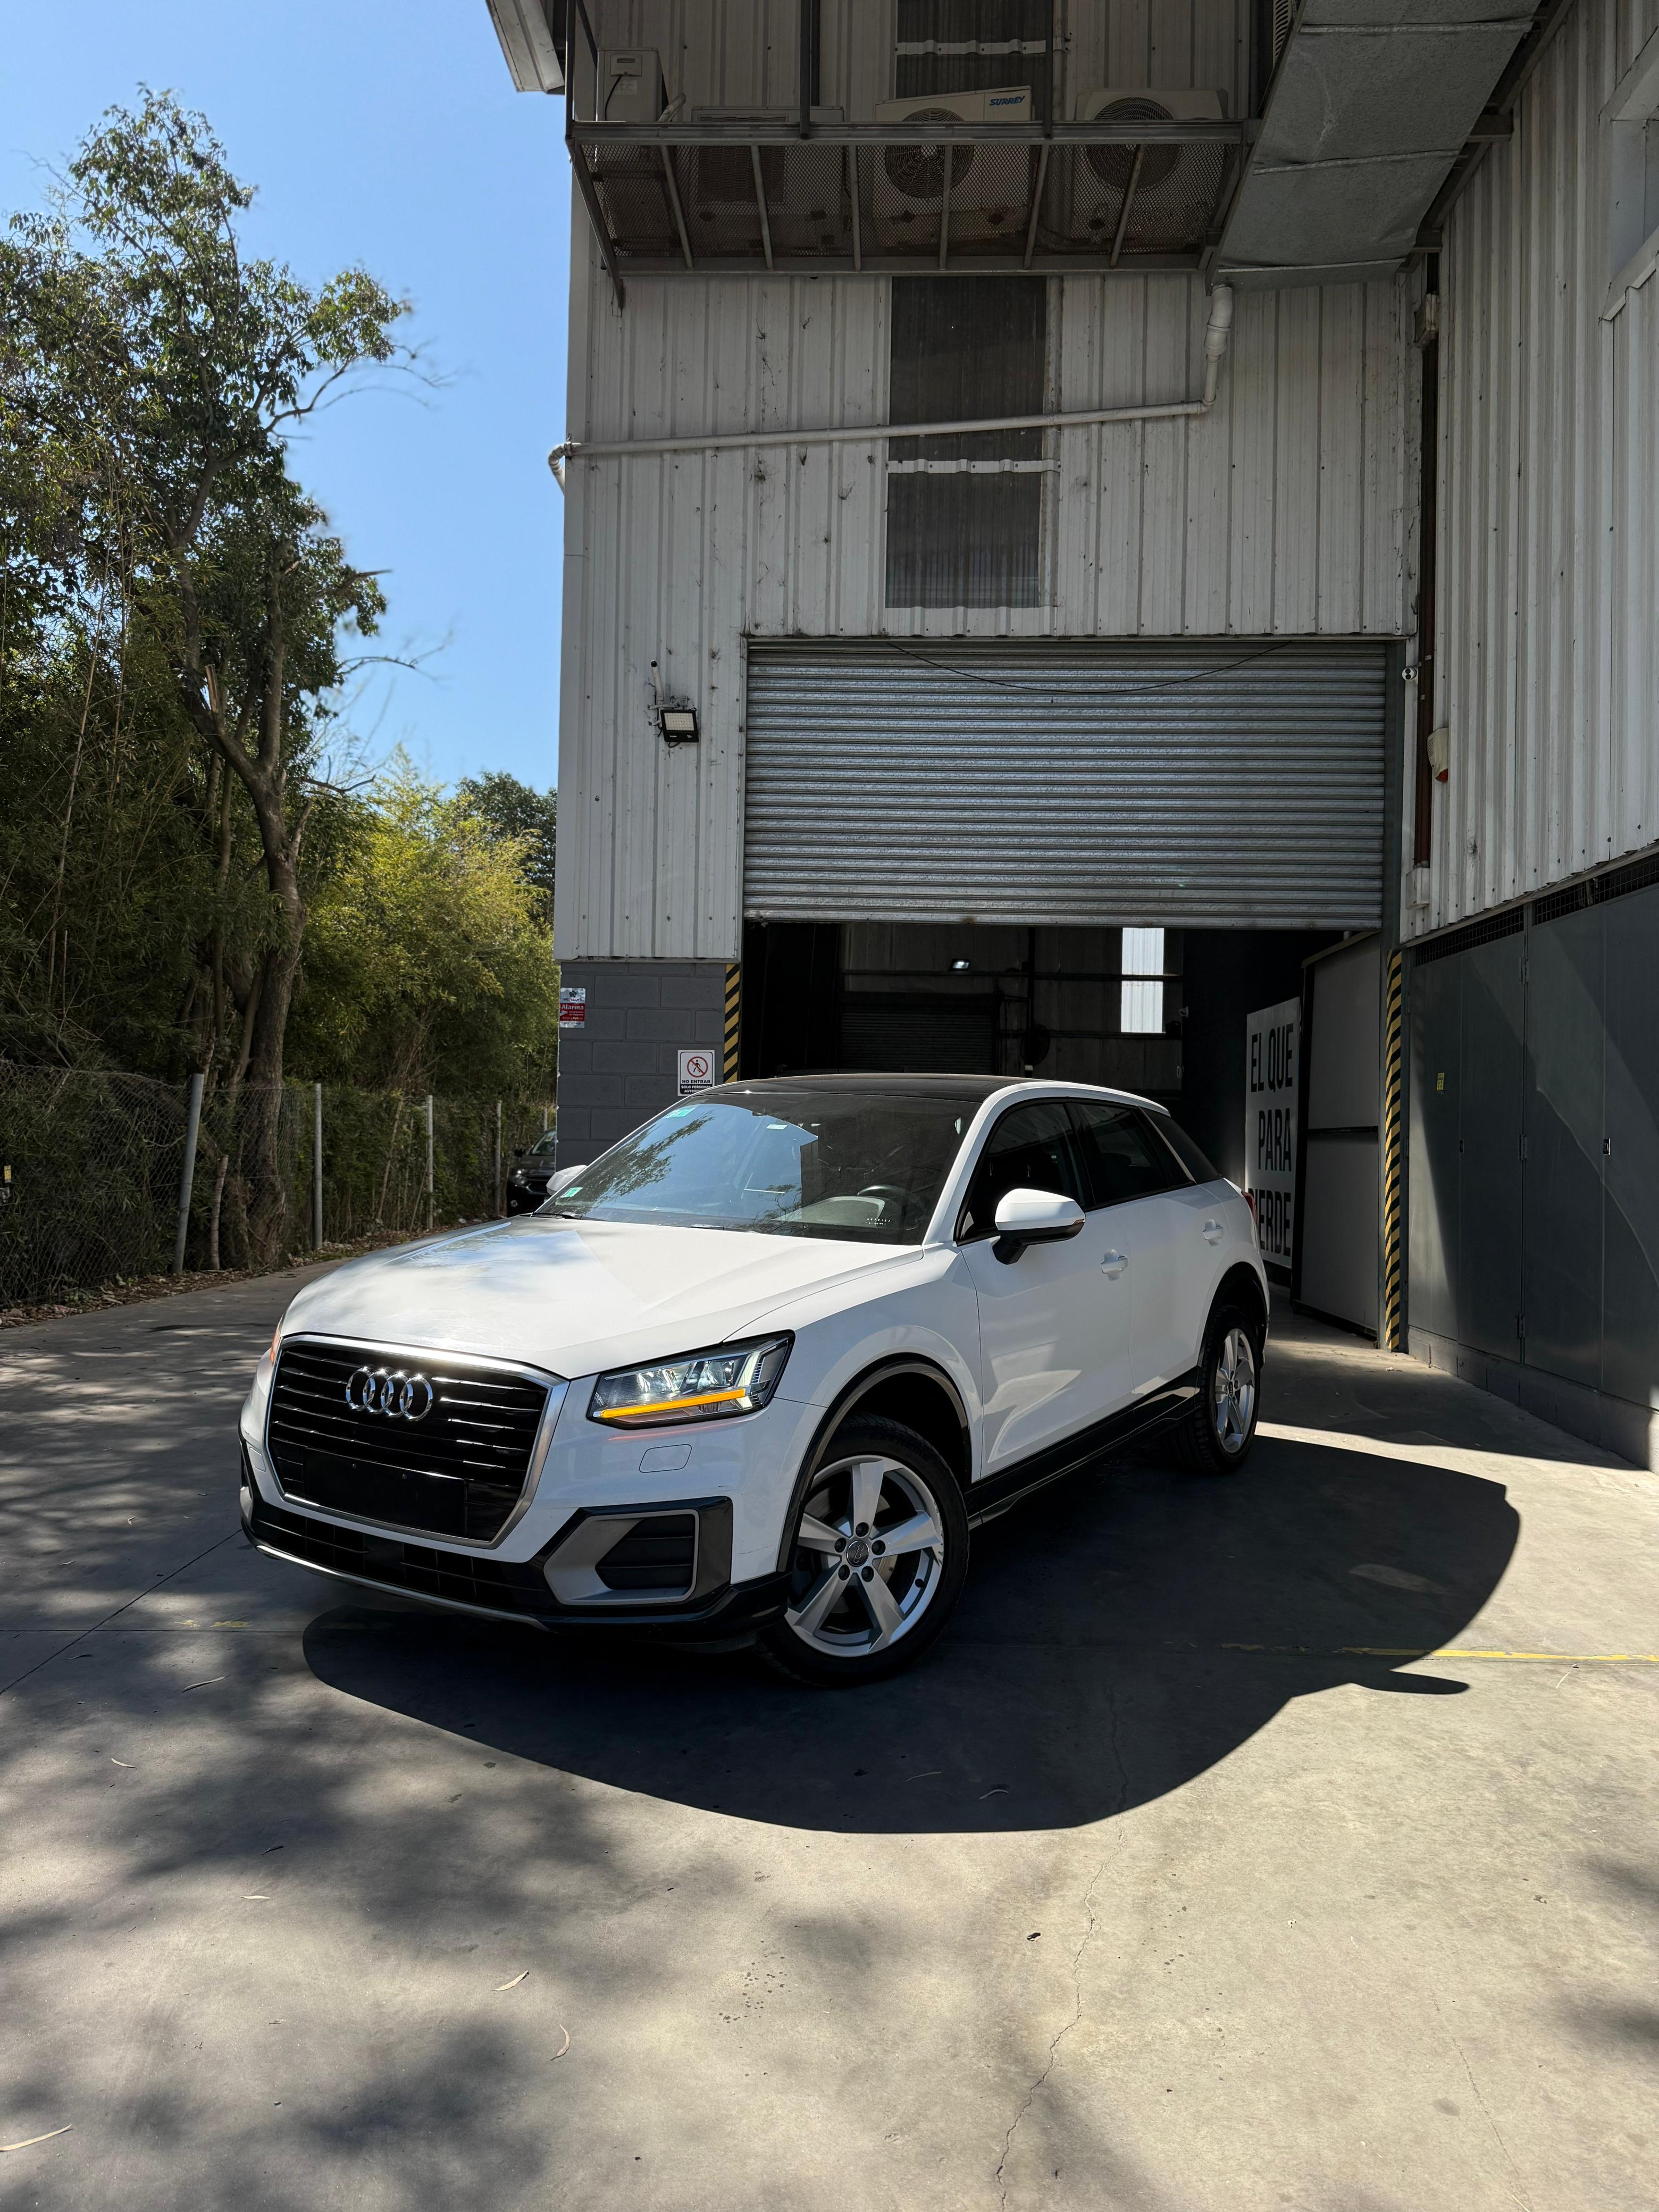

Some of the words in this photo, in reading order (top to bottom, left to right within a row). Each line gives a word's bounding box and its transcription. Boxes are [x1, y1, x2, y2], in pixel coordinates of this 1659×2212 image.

[990, 96, 1025, 106] SURREY
[1251, 1033, 1264, 1092] EL
[1268, 1023, 1294, 1093] QUE
[1259, 1108, 1292, 1171] PARA
[1248, 1188, 1291, 1256] ERDE
